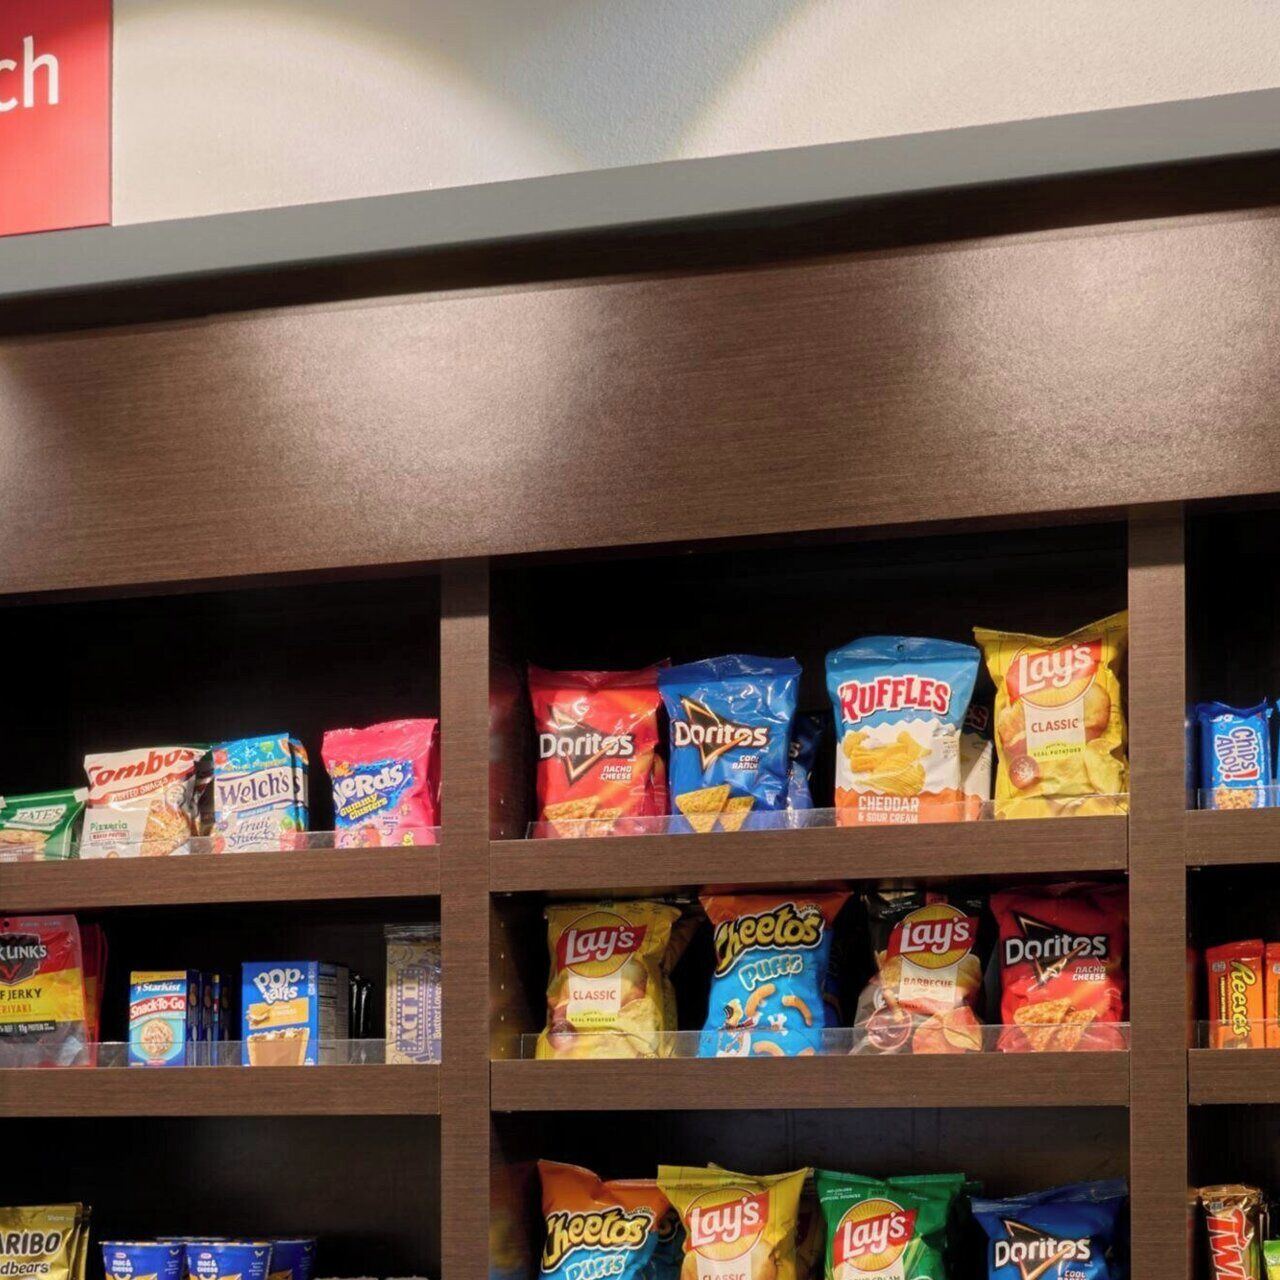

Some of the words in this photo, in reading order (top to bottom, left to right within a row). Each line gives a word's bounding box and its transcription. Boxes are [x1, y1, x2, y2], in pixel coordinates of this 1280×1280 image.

[1020, 644, 1095, 695] Lay's
[840, 677, 951, 722] RUFFLES
[674, 722, 768, 746] Doritos
[1031, 718, 1078, 732] CLASSIC
[539, 733, 634, 758] Doritos
[1231, 728, 1256, 774] Chips
[218, 770, 289, 804] Welch's
[19, 808, 63, 821] TATE'S
[858, 797, 920, 812] CHEDDAR
[866, 813, 887, 823] SOUR
[890, 813, 918, 824] CREAM
[90, 821, 127, 831] Pizzeria
[565, 926, 635, 965] Lay's
[715, 903, 823, 976] Cheetos
[900, 916, 970, 954] Lay's
[1006, 936, 1107, 966] Doritos
[143, 982, 181, 991] StarKist
[739, 955, 804, 990] PUFFS
[7, 988, 41, 1000] JERKY
[573, 989, 616, 1001] CLASSIC
[1229, 961, 1256, 1037] Reese's
[402, 1006, 418, 1045] ACT
[432, 1010, 442, 1040] Butter
[690, 1198, 761, 1246] Lay's
[843, 1212, 908, 1258] Lay's
[542, 1208, 650, 1271] Cheetos
[995, 1239, 1091, 1268] Doritos
[1065, 1270, 1085, 1278] COOL
